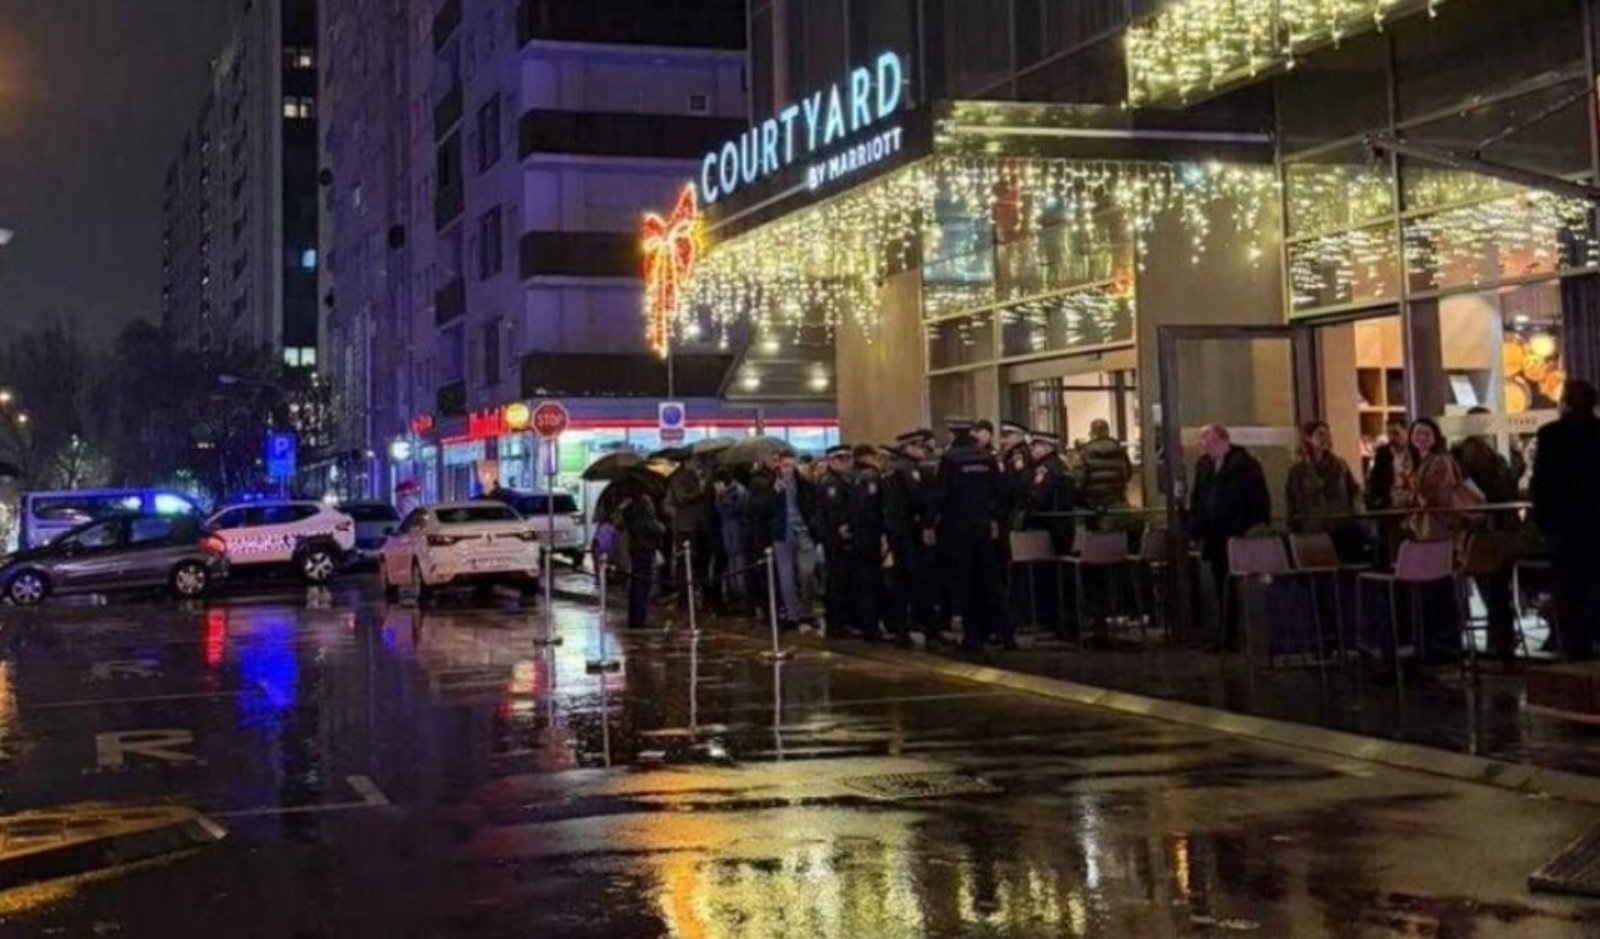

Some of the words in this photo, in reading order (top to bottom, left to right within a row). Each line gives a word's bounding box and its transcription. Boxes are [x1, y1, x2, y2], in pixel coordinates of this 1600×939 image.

[702, 51, 902, 203] COURTYARD
[808, 161, 828, 190] BY
[829, 126, 903, 181] MARRIOTT
[537, 412, 565, 427] STOP
[274, 436, 289, 457] P
